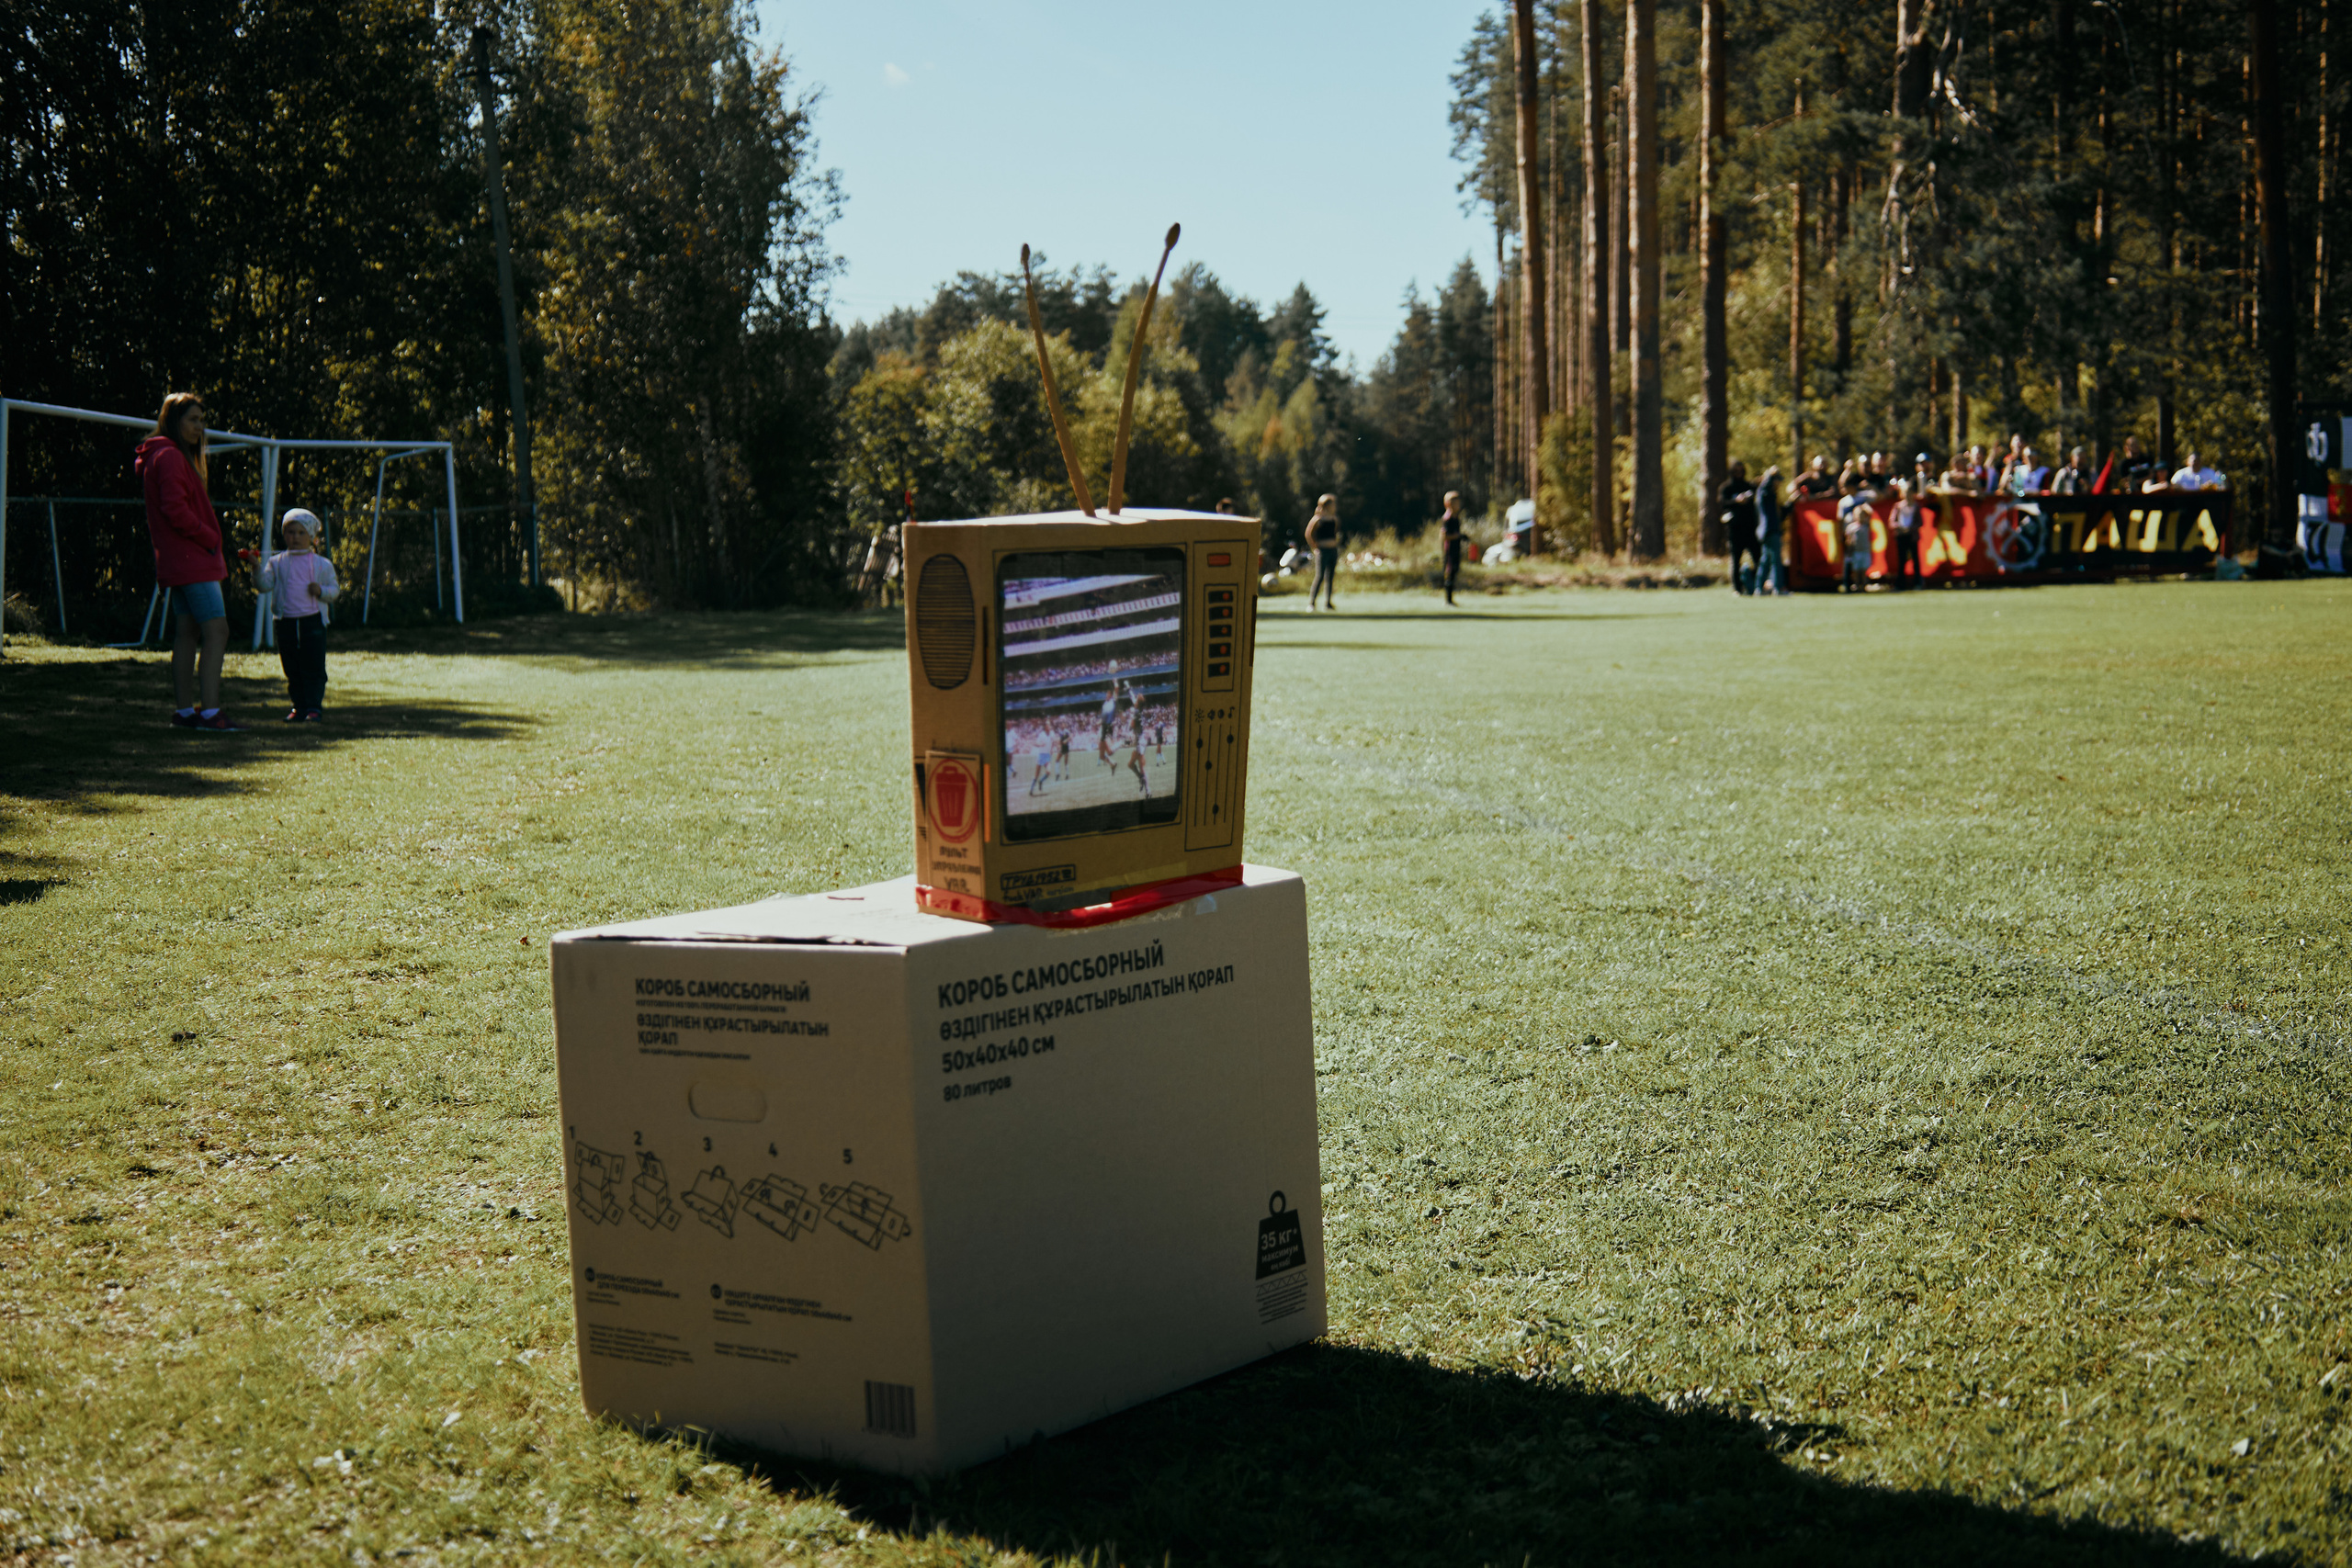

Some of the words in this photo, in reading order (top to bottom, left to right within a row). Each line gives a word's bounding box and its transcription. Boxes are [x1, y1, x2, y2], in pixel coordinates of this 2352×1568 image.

[2051, 509, 2220, 553] ПАША
[944, 876, 970, 893] VAR
[938, 973, 1008, 1009] КОРОБ
[1012, 939, 1164, 993] САМОСБОРНЫЙ
[636, 978, 684, 997] КОРОБ
[687, 980, 810, 1001] САМОСБОРНЫЙ
[939, 1006, 1030, 1042] ӨЗДІГІНЕН
[1033, 974, 1185, 1025] ҚҰРАСТЫРЫЛАТЫН
[1188, 964, 1234, 993] ҚОРАП
[637, 1013, 701, 1030] ӨЗДІГІНЕН
[703, 1017, 830, 1036] ҚҰРАСТЫРЫЛАТЫН
[638, 1031, 678, 1046] ҚОРАП
[1033, 1034, 1055, 1054] см
[944, 1084, 962, 1102] 80
[963, 1075, 1012, 1100] литров
[568, 1125, 575, 1139] 1
[634, 1131, 642, 1145] 2
[703, 1137, 712, 1152] 3
[768, 1143, 777, 1157] 4
[842, 1148, 853, 1164] 5
[1261, 1230, 1276, 1251] 35
[1261, 1245, 1298, 1263] максимум
